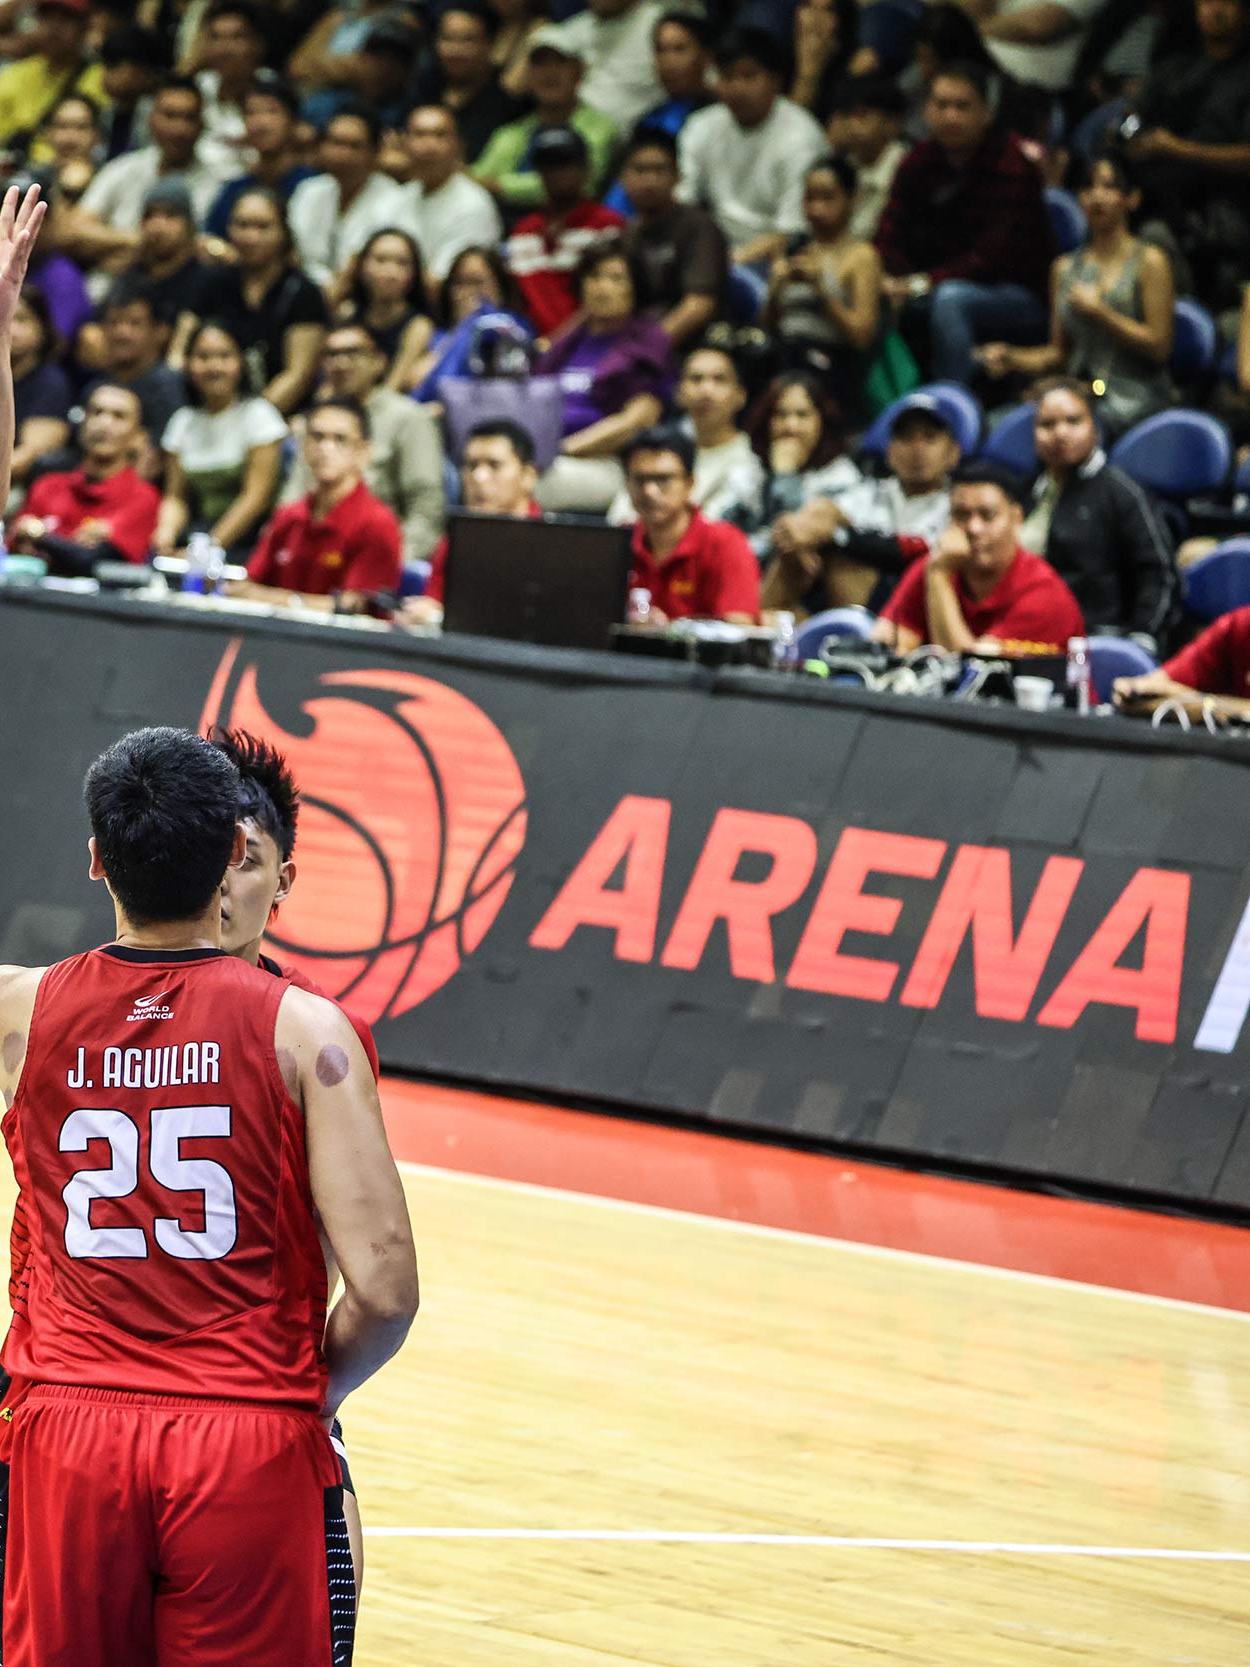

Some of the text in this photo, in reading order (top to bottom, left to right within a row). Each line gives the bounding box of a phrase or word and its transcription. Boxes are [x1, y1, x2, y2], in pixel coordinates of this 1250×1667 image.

[126, 1012, 175, 1022] BALANCE
[133, 1005, 170, 1015] WORLD
[67, 1040, 222, 1089] J. AGUILAR
[57, 1104, 239, 1262] 25
